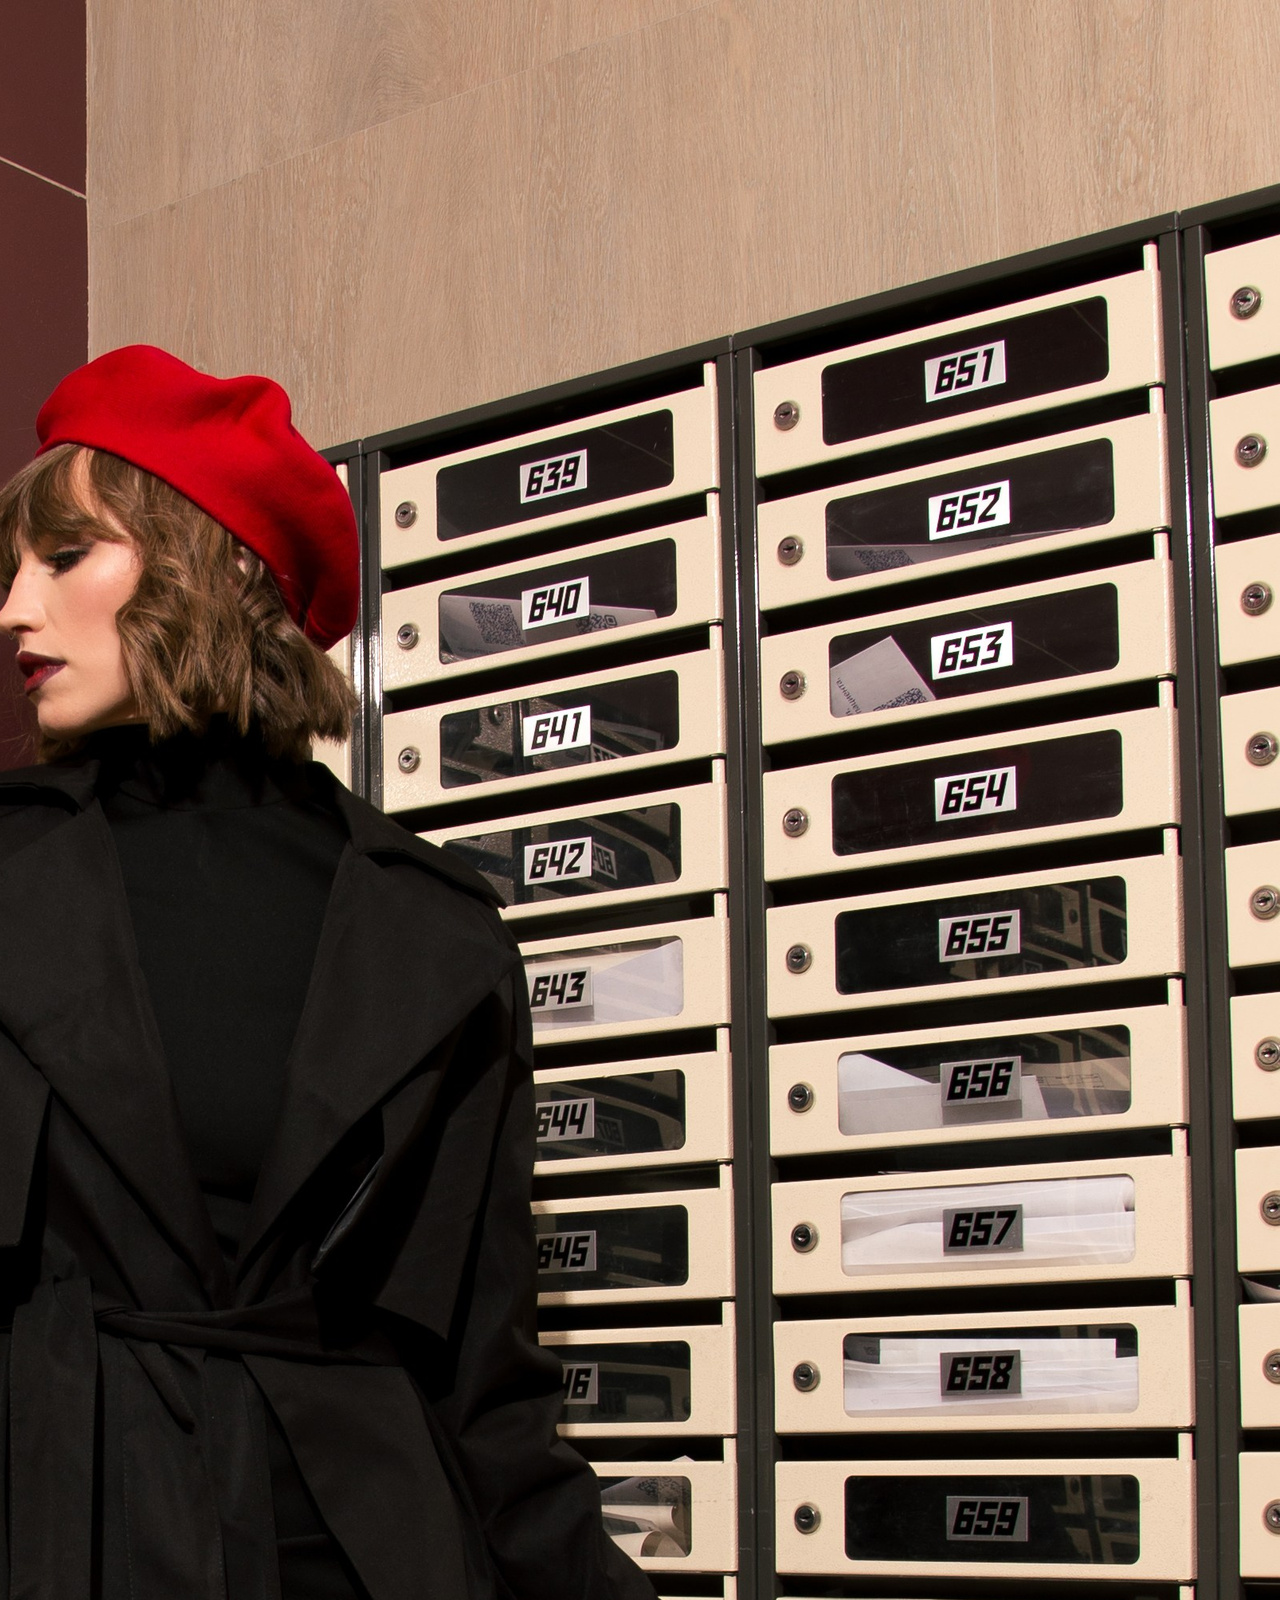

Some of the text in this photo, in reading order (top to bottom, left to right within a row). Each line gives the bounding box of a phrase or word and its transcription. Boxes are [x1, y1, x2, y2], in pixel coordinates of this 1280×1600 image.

[934, 348, 994, 394] 651
[525, 455, 581, 497] 639
[936, 487, 1001, 532] 652
[528, 582, 582, 623] 640
[938, 629, 1004, 673] 653
[531, 712, 582, 750] 641
[941, 772, 1008, 815] 654
[529, 842, 585, 879] 642
[945, 915, 1012, 956] 655
[531, 971, 586, 1008] 643
[947, 1061, 1014, 1101] 656
[537, 1102, 589, 1136] 644
[948, 1210, 1017, 1247] 657
[538, 1235, 591, 1268] 645
[946, 1355, 1014, 1391] 658
[952, 1501, 1020, 1536] 659
